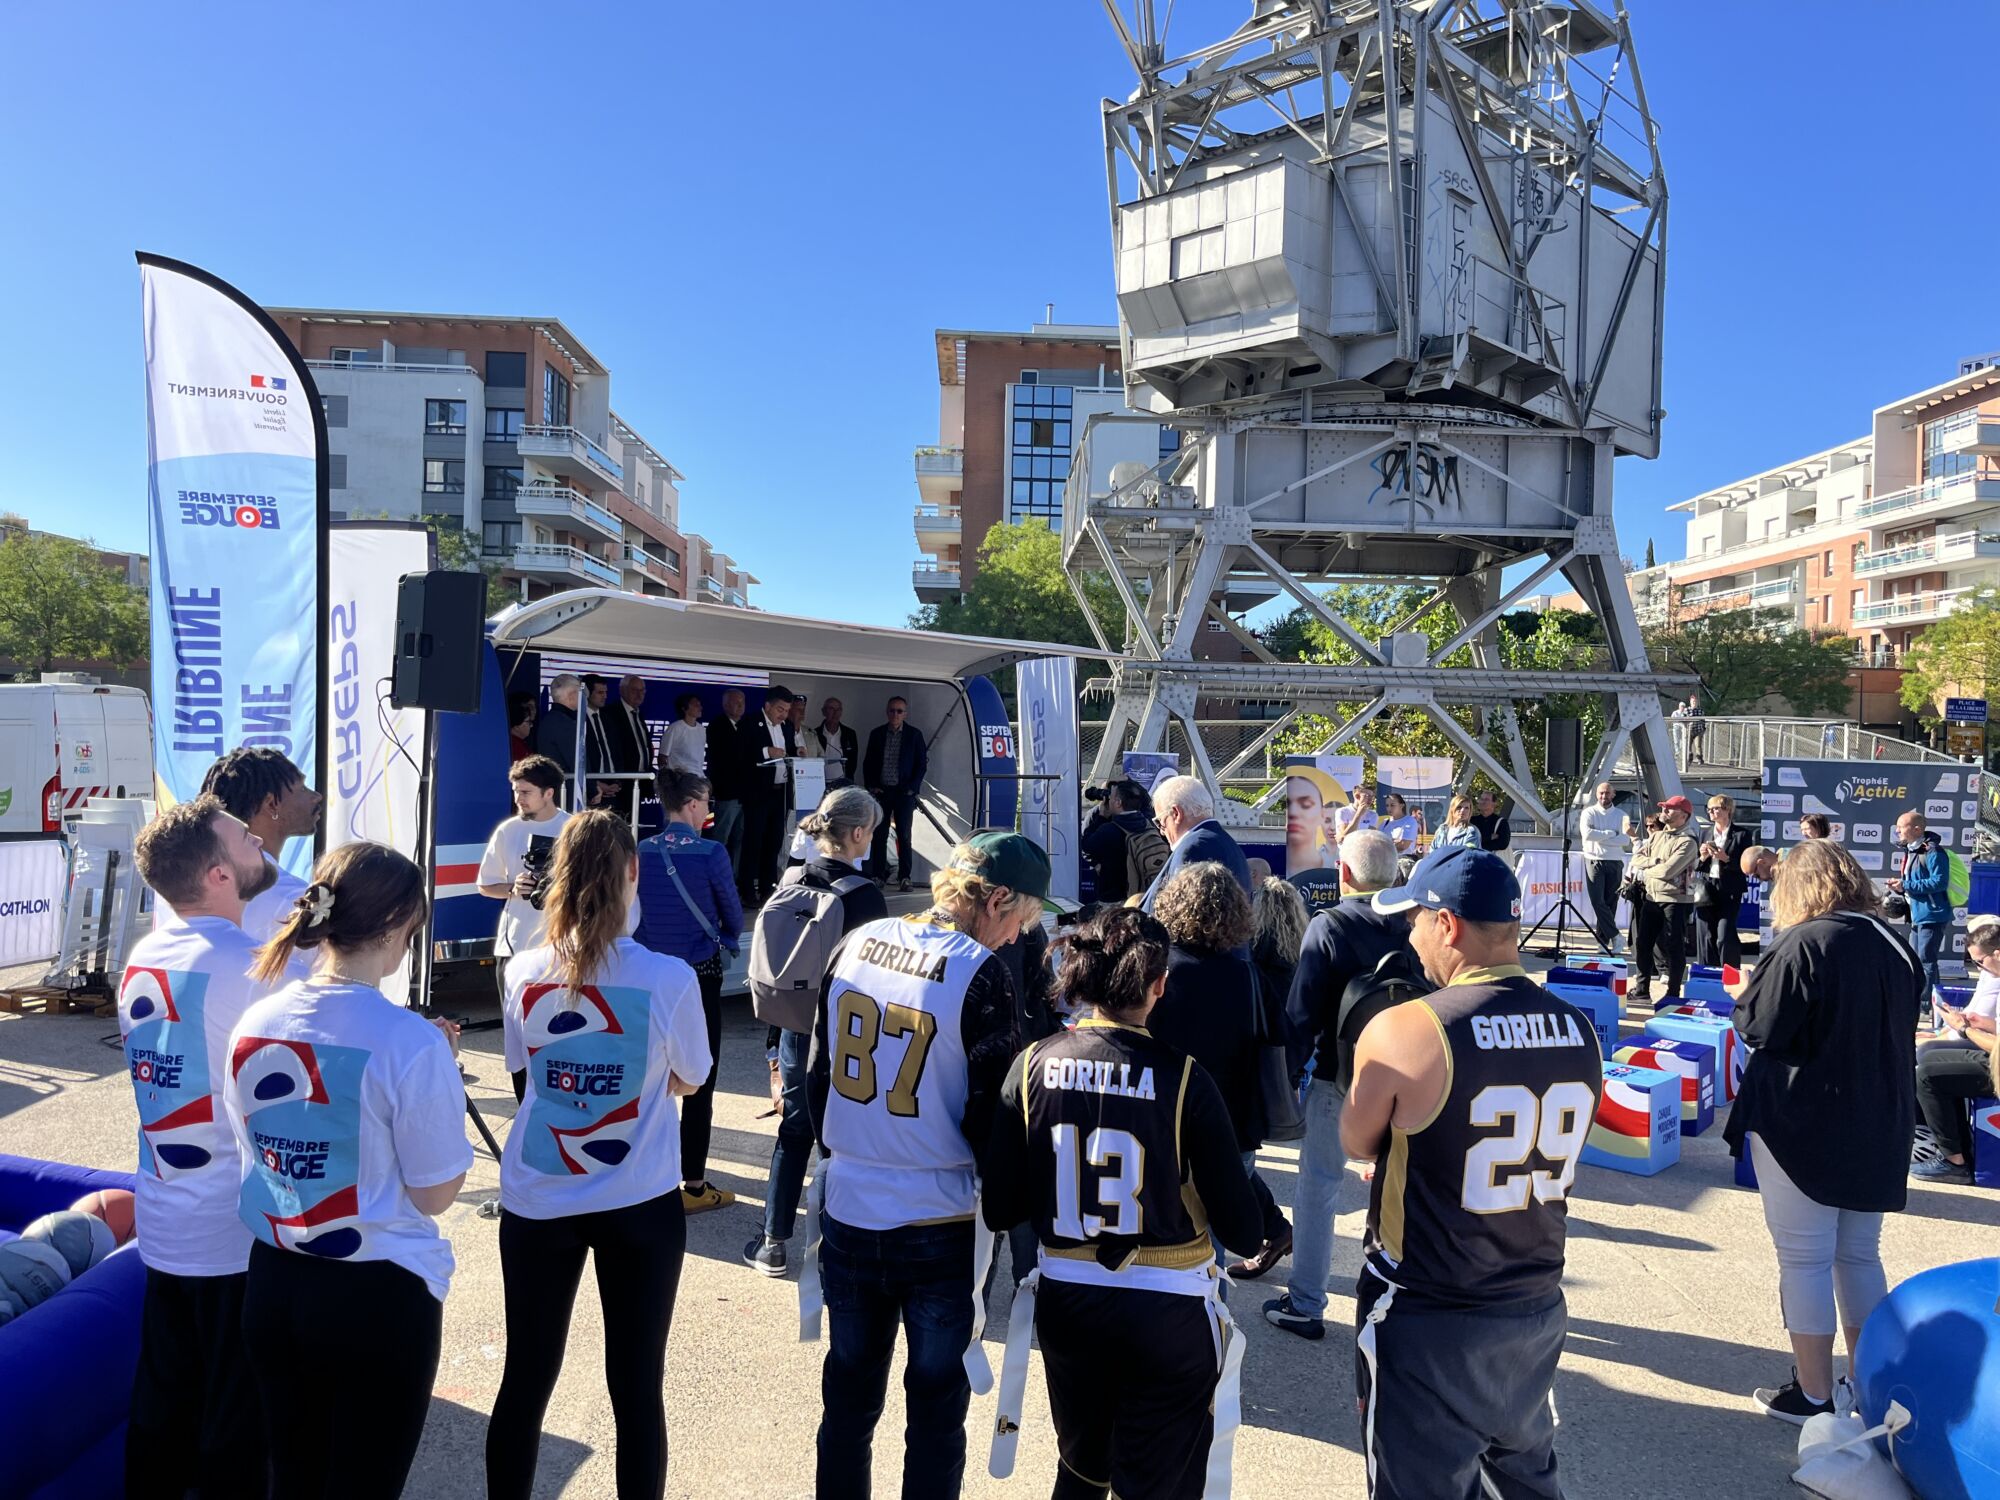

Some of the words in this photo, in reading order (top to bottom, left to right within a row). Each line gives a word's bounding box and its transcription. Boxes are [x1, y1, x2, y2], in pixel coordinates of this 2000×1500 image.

[981, 736, 1015, 758] BOU
[1853, 785, 1907, 799] ActivE
[1856, 829, 1878, 837] FIBO
[857, 937, 949, 983] GORILLA
[1470, 1013, 1585, 1050] GORILLA
[546, 1060, 625, 1074] SEPTEMBRE
[831, 989, 938, 1118] 87
[546, 1069, 623, 1095] BOUGE
[1043, 1057, 1156, 1100] GORILLA
[254, 1131, 331, 1153] SEPTEMBRE
[1461, 1081, 1595, 1214] 29
[1050, 1122, 1145, 1241] 13
